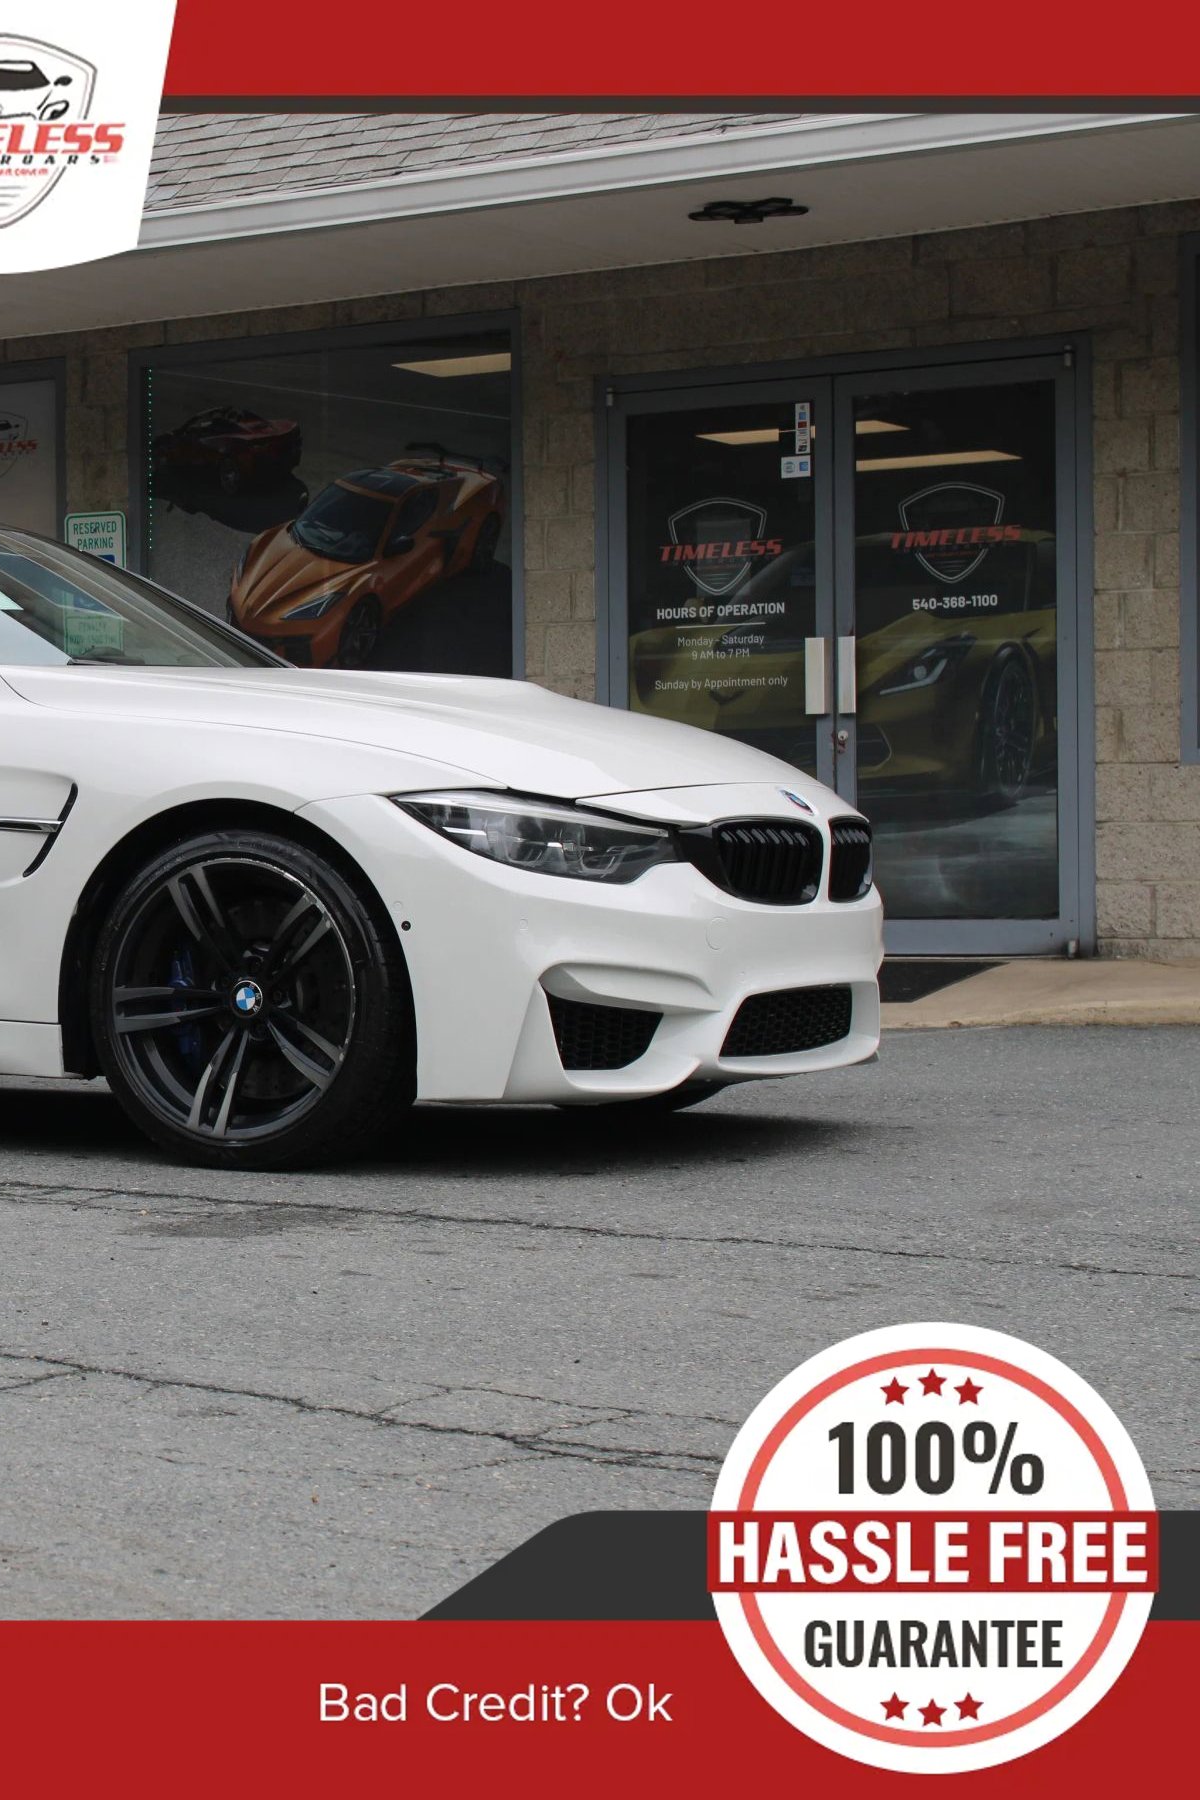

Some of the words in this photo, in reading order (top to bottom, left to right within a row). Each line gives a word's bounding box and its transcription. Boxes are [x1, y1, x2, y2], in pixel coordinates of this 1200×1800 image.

[73, 521, 117, 535] RESERVED
[77, 537, 114, 550] PARKING
[890, 525, 1021, 549] TIMELESS
[659, 539, 784, 561] TIMELESS
[912, 594, 998, 610] 540-368-1100
[656, 607, 697, 620] HOURS
[699, 605, 715, 618] OF
[717, 602, 785, 617] OPERATION
[677, 636, 714, 648] Monday
[721, 633, 765, 645] Saturday
[691, 650, 698, 660] 9
[699, 650, 714, 660] AM
[715, 650, 726, 659] to
[728, 649, 734, 659] 7
[735, 648, 750, 658] PM
[655, 680, 689, 692] Sunday
[691, 679, 701, 690] by
[704, 676, 766, 690] Appointment
[768, 675, 788, 687] only
